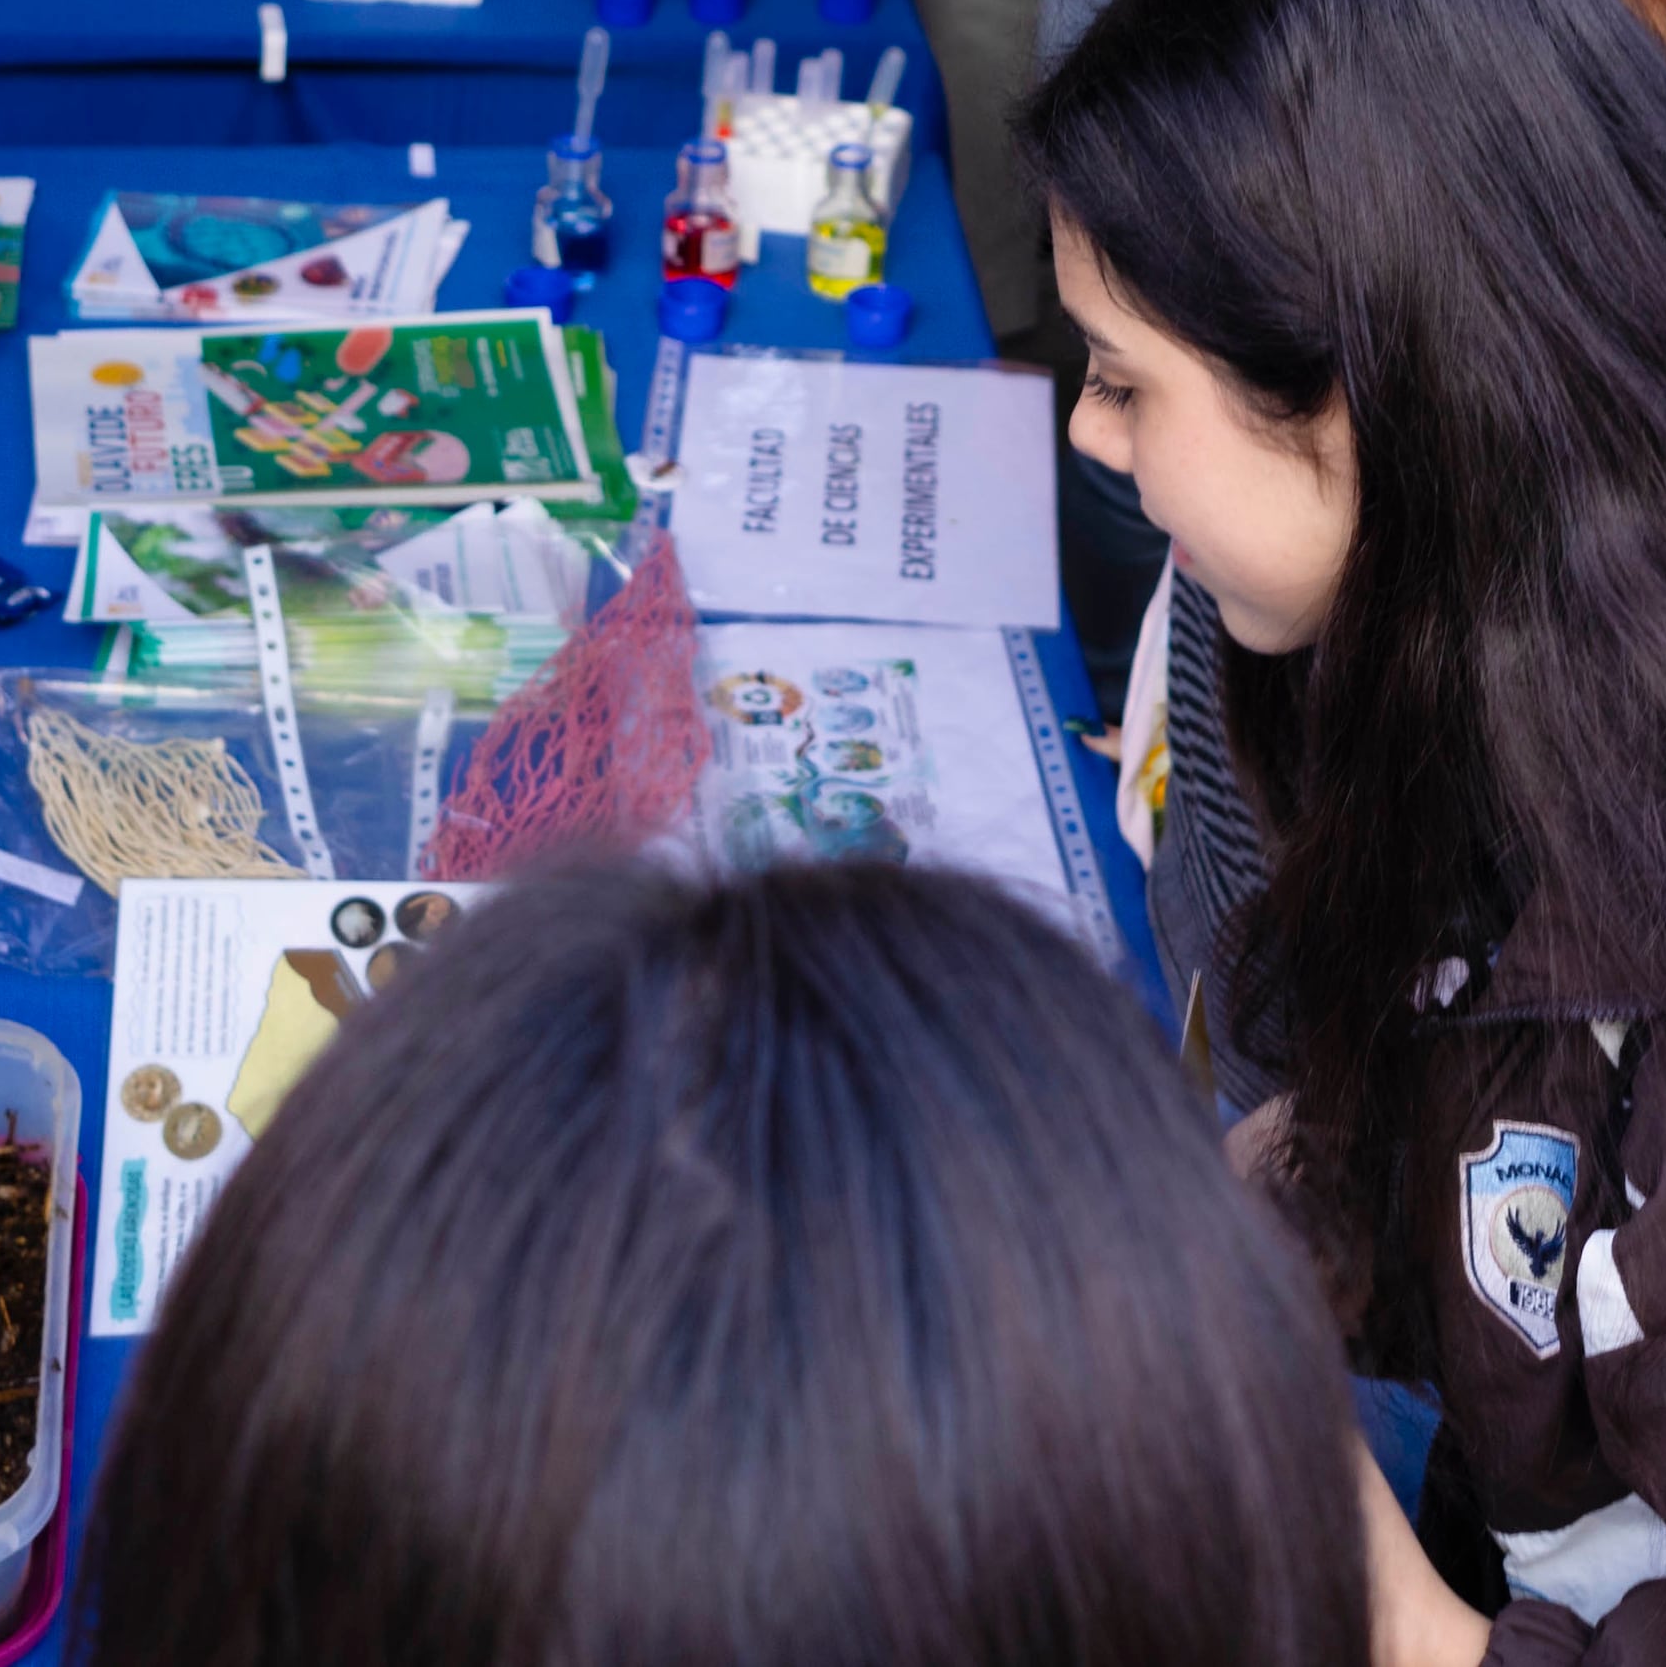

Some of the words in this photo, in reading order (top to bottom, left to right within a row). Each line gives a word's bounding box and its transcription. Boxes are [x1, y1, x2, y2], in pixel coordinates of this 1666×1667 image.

[86, 405, 132, 493] OLAVIDE
[125, 390, 168, 473] FUTURO
[824, 423, 862, 512] CIENCIAS
[742, 428, 785, 533] FACULTAD
[899, 402, 940, 581] EXPERIMENTALES
[821, 516, 858, 546] DE
